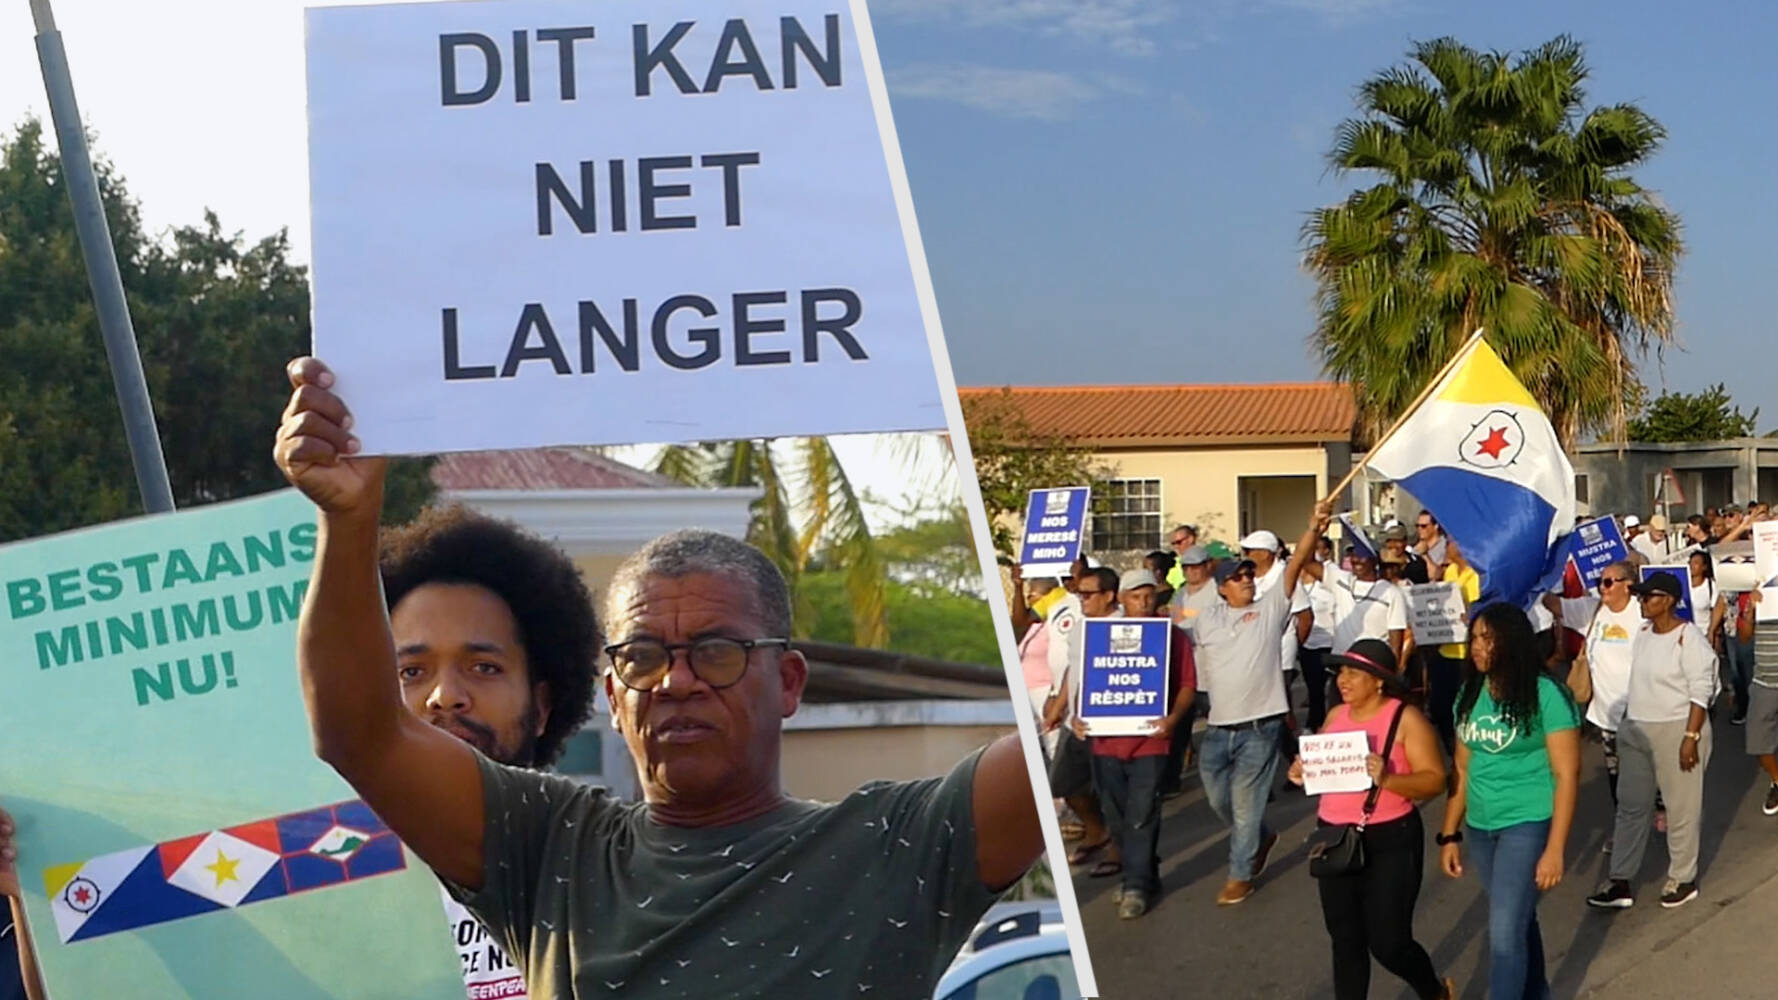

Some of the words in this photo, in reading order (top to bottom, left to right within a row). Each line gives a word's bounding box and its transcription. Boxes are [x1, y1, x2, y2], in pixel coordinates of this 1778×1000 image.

[438, 26, 595, 106] DIT
[632, 14, 842, 97] KAN
[535, 152, 760, 236] NIET
[442, 288, 869, 380] LANGER
[1041, 515, 1069, 528] NOS
[1577, 539, 1617, 558] MUSTRA
[6, 522, 318, 620] BESTAANS
[1591, 552, 1612, 565] NOS
[35, 579, 310, 670] MINIMUM
[131, 650, 239, 706] NU!
[1093, 656, 1157, 669] MUSTRA
[1108, 673, 1141, 686] NOS
